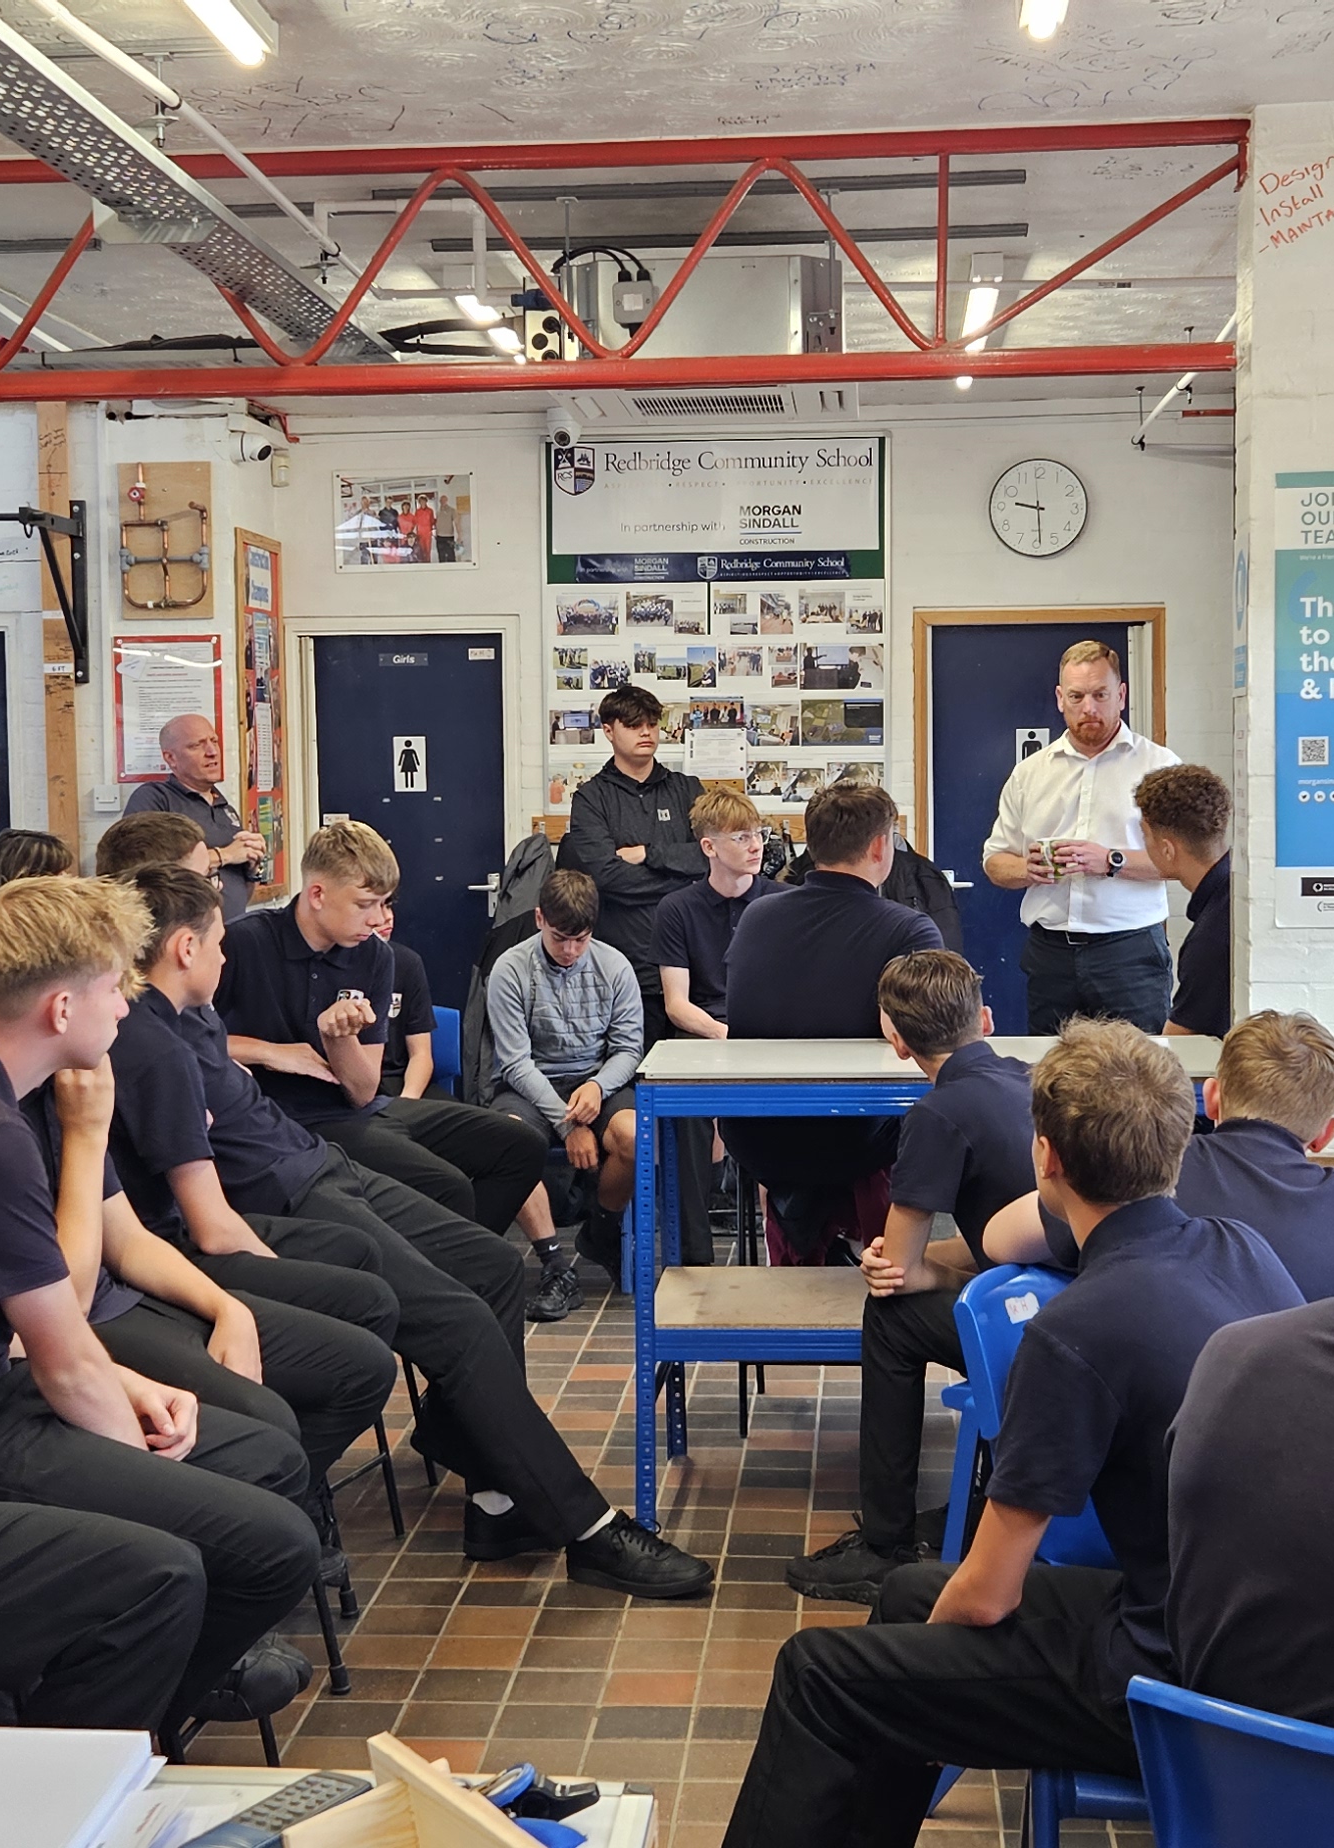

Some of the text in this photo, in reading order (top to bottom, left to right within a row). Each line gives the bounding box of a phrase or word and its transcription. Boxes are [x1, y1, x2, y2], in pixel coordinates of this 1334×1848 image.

[604, 447, 874, 480] Redbridge Community School
[739, 504, 802, 516] MORGAN
[620, 522, 631, 533] In
[634, 521, 698, 535] partnership
[739, 517, 800, 529] SINDALL
[739, 537, 795, 546] CONSTRUCTION
[634, 557, 669, 566] MORGAN
[720, 556, 845, 572] Redbridge Community School
[1299, 626, 1330, 645] to
[392, 654, 416, 664] Girls
[1299, 678, 1323, 700] &
